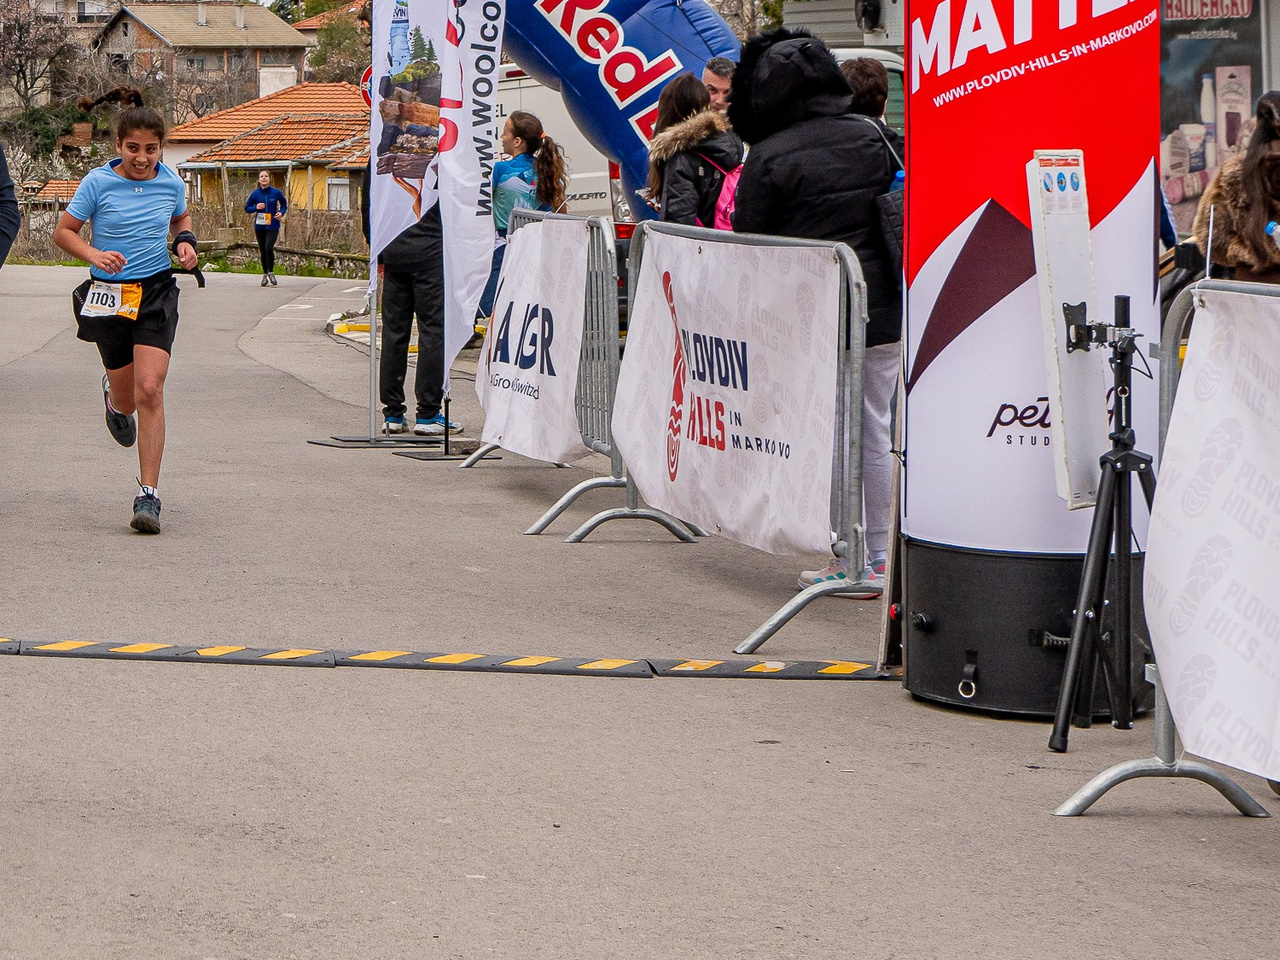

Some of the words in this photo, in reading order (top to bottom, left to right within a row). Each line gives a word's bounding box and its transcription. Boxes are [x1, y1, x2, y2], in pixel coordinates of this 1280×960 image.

[933, 8, 1158, 108] WWW.PLOVDIV-HILLS-IN-MARKOVO.COM
[90, 291, 116, 308] 1103
[729, 410, 742, 427] IN
[731, 433, 791, 460] MARKOVO
[1006, 434, 1051, 446] STUD
